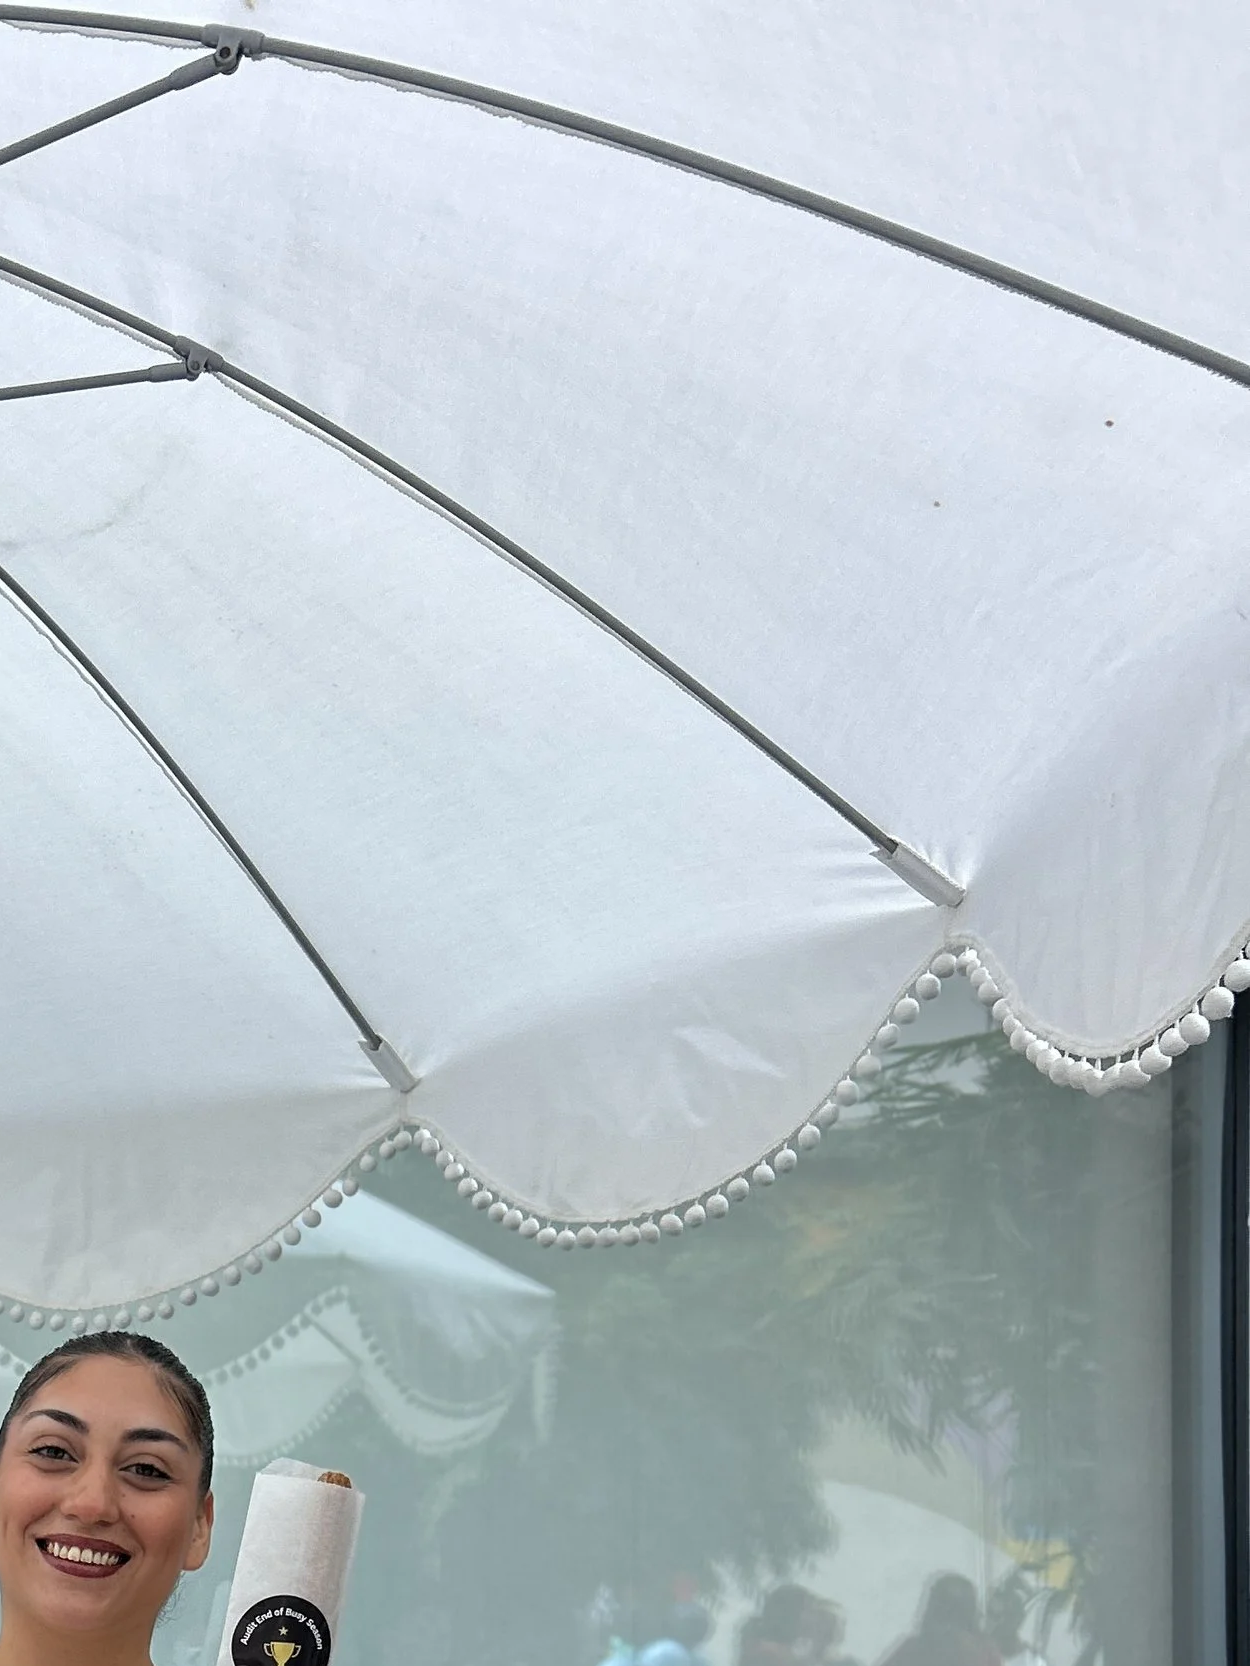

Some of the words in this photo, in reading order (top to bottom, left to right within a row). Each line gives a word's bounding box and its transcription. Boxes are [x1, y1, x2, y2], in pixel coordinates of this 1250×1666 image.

[240, 1621, 258, 1645] Audit
[255, 1610, 273, 1624] End
[274, 1607, 284, 1616] of
[285, 1608, 307, 1623] Busy
[306, 1618, 323, 1650] Season
